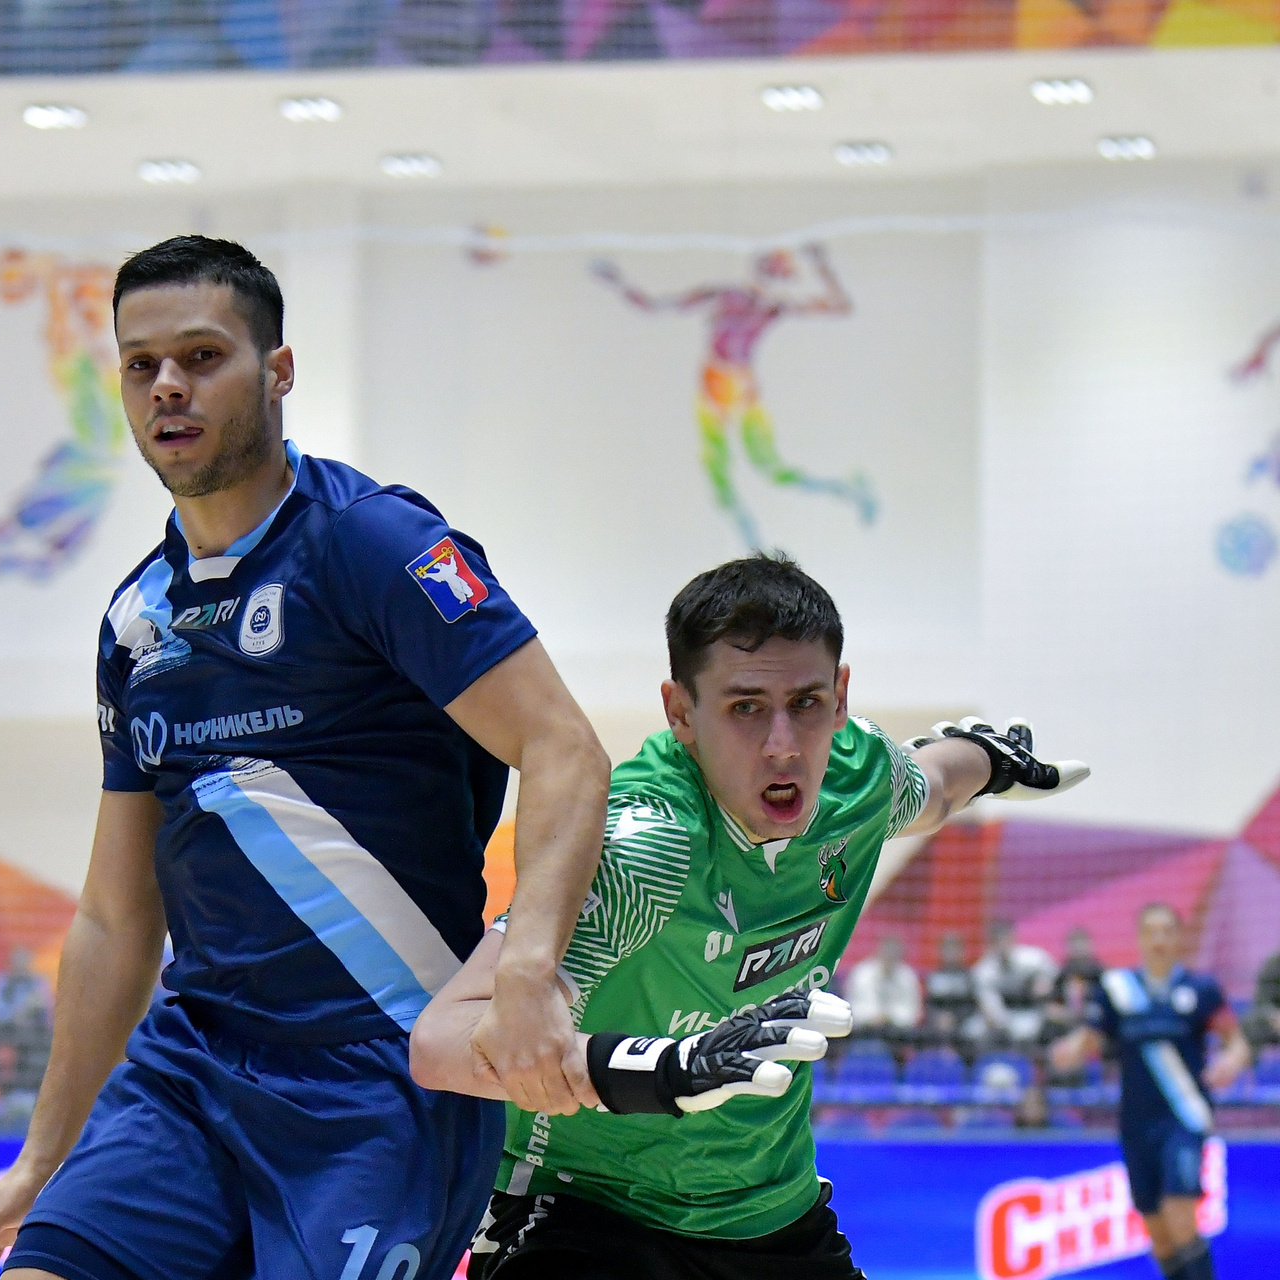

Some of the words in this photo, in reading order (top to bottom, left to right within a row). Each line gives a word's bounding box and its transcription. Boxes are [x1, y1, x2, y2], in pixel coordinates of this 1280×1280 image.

[171, 596, 241, 627] PARI
[174, 704, 304, 746] НОРНИКЕЛЬ
[738, 921, 826, 983] PARI
